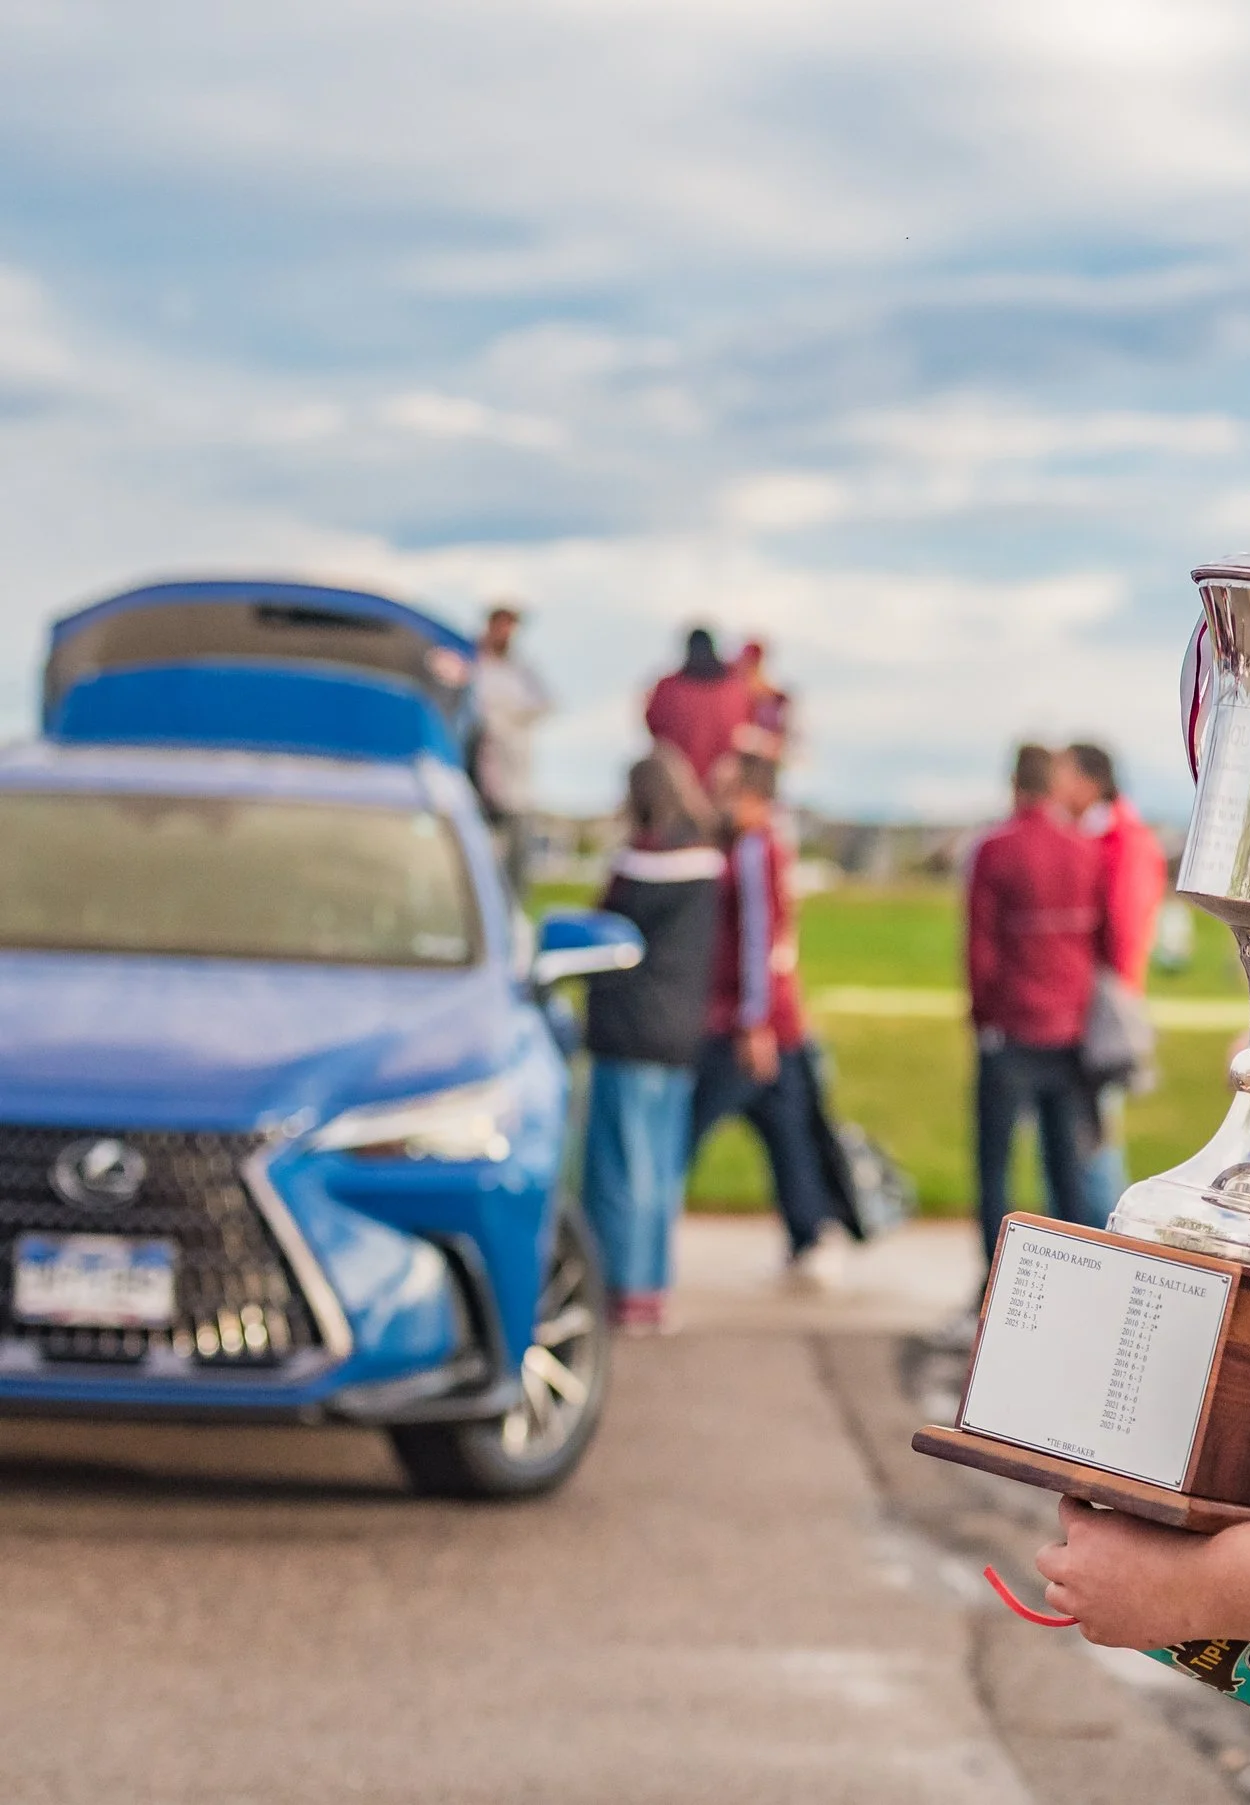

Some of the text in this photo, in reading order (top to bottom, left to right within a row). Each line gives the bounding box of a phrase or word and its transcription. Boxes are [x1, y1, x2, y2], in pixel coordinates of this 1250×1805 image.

[1023, 1242, 1101, 1270] COLORADO RAPIDS
[1019, 1257, 1033, 1266] 2005
[1017, 1267, 1030, 1277] 2006
[1135, 1271, 1206, 1297] REAL SALT LAKE
[1012, 1287, 1025, 1297] 2015
[1132, 1286, 1146, 1296] 2007
[1010, 1297, 1023, 1307] 2020
[1007, 1308, 1021, 1316] 2024
[1127, 1307, 1141, 1316] 2009
[1005, 1318, 1018, 1327] 2025
[1124, 1317, 1138, 1327] 2010
[1122, 1328, 1135, 1337] 2011
[1119, 1338, 1133, 1347] 2012
[1117, 1348, 1131, 1357] 2014
[1115, 1358, 1128, 1368] 2016
[1112, 1369, 1126, 1377] 2017
[1107, 1389, 1122, 1398] 2019
[1105, 1399, 1118, 1409] 2021
[1103, 1410, 1116, 1419] 2022
[1100, 1420, 1114, 1429] 2023
[1063, 1442, 1095, 1457] BREAKER
